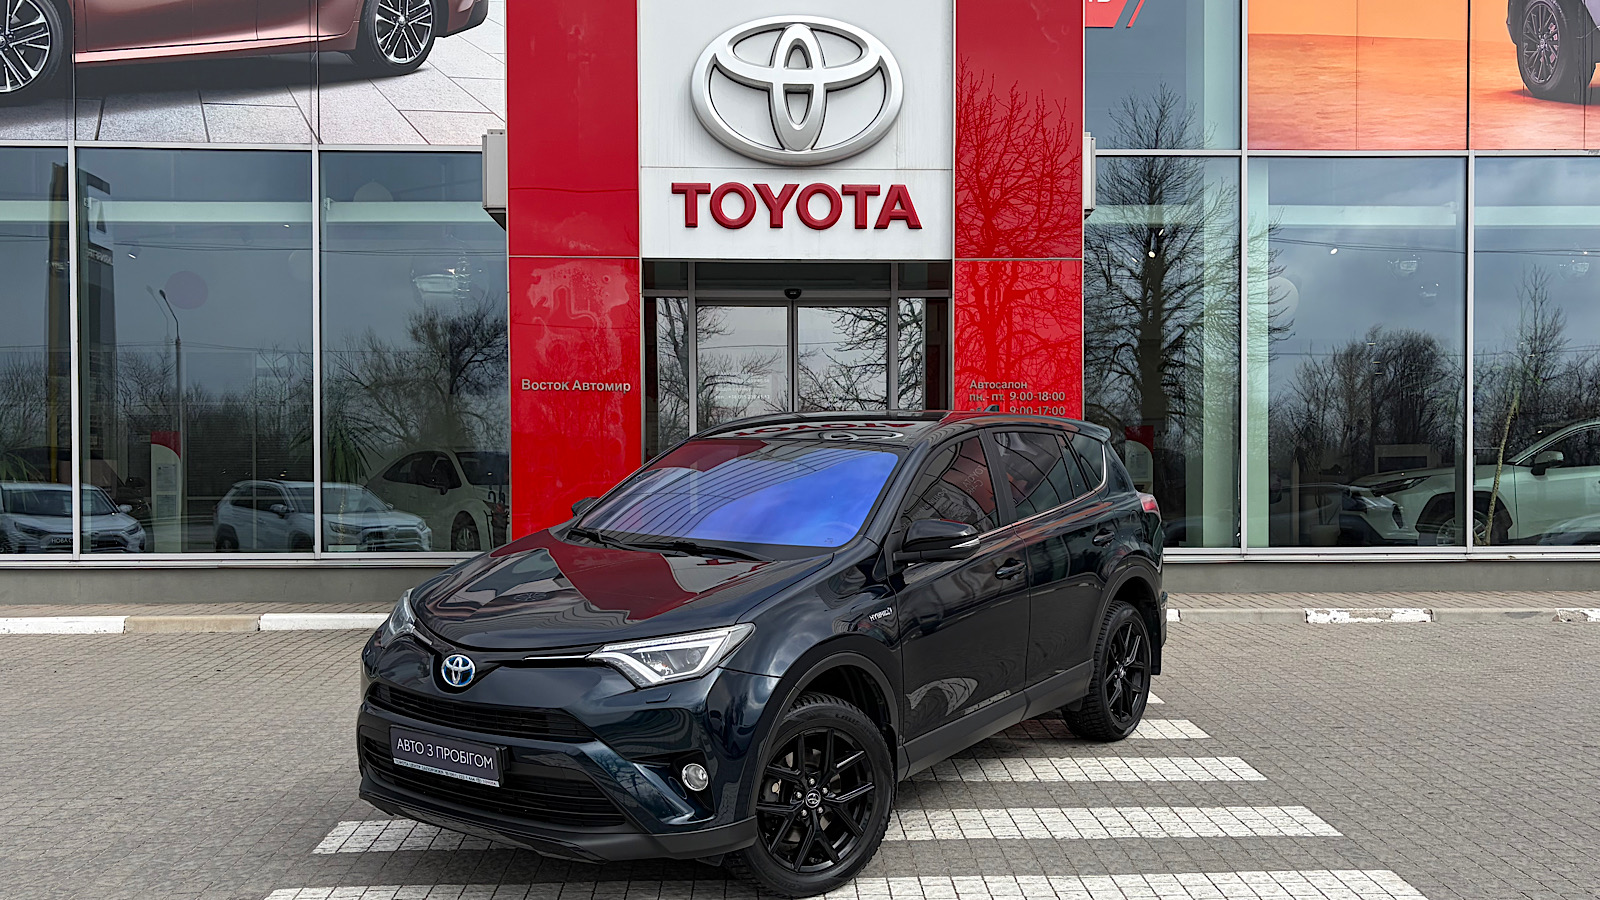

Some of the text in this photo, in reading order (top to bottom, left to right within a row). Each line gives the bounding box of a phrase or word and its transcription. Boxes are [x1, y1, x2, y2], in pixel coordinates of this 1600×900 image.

[671, 181, 923, 230] TOYOTA
[521, 378, 632, 394] Восток Автомир
[969, 379, 1028, 390] Автосалон
[1009, 391, 1066, 402] 9:00-18:00
[1009, 406, 1066, 416] 9:00-17:00
[396, 738, 494, 770] АВТО З ПРОБІГОМ
